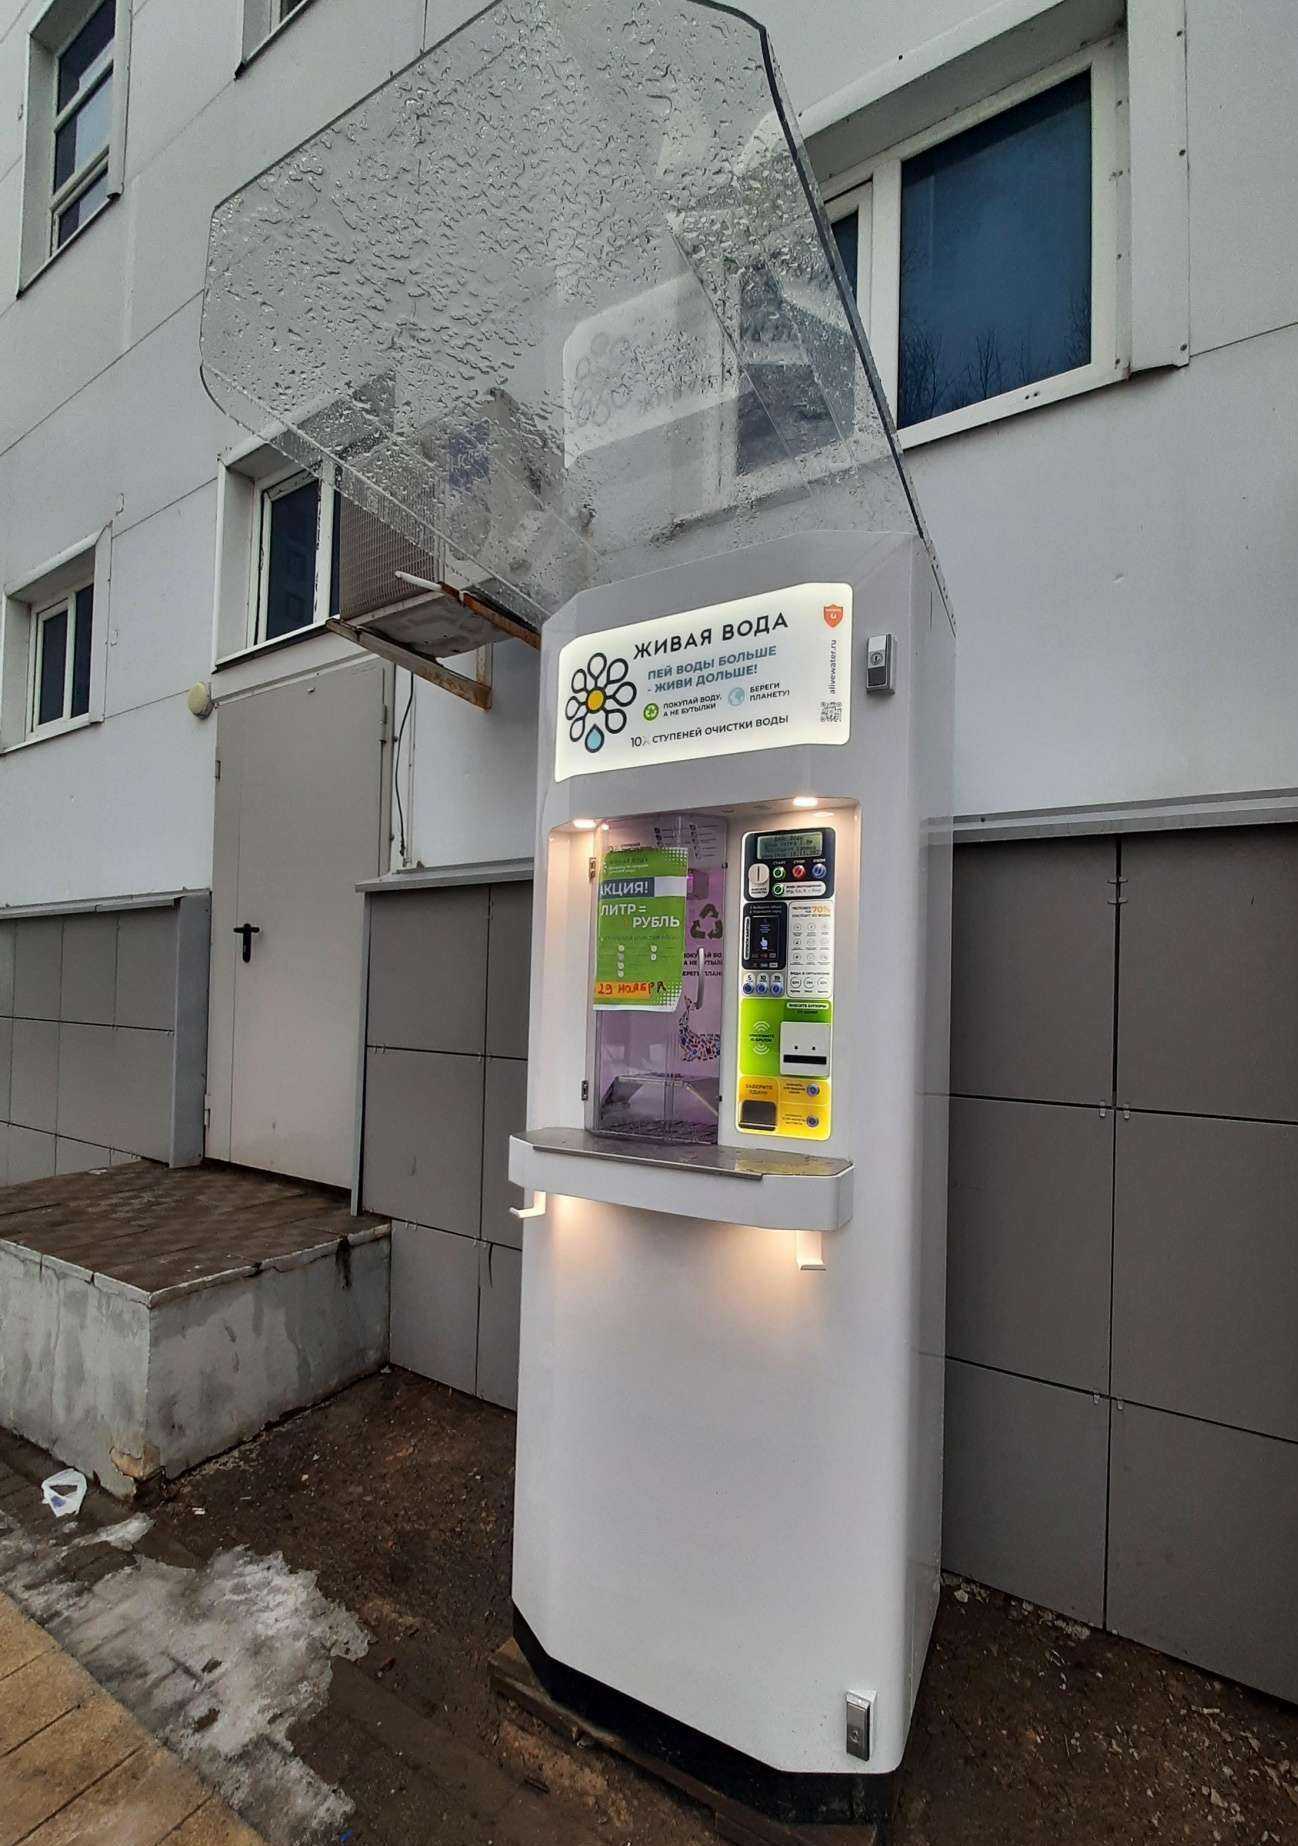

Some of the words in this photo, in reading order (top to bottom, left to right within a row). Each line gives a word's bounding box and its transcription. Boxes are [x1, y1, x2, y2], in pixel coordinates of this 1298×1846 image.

[633, 628, 712, 660] ЖИВАЯ
[722, 612, 788, 641] ВОДА
[648, 666, 672, 680] ПЕЙ
[676, 659, 715, 675] ВОДЫ
[719, 645, 777, 666] БОЛЬШЕ
[829, 639, 837, 695] alivewater.ru
[654, 677, 692, 693] ЖИВИ
[696, 664, 758, 687] ДОЛЬШЕ!
[749, 683, 780, 693] БЕРЕГИ
[749, 690, 790, 702] ПЛАНЕТУ!
[663, 697, 698, 709] ПОКУПАЙ
[681, 703, 717, 714] БУТЫЛКИ
[652, 727, 702, 743] СТУПЕНЕЙ
[705, 720, 753, 735] ОЧИСТКИ
[755, 715, 789, 727] ВОДЫ
[600, 904, 637, 916] ЛИТР
[632, 915, 680, 928] РУБЛЬ
